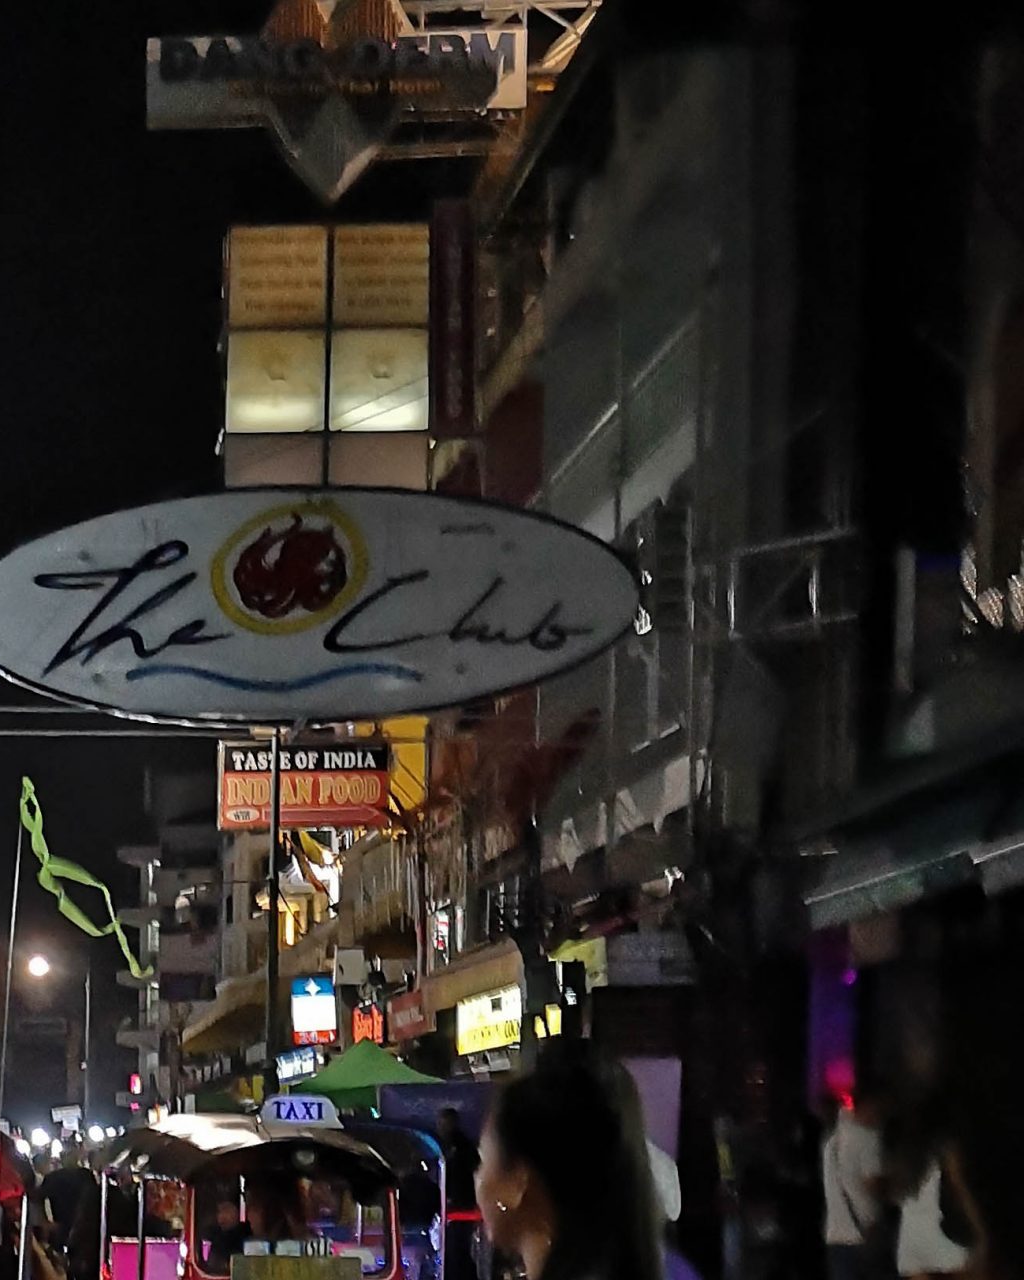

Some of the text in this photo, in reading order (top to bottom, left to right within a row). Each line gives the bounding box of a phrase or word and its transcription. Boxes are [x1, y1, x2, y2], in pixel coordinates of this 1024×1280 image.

[33, 538, 595, 679] The Club
[231, 749, 377, 771] TASE OF INDIA
[226, 774, 382, 807] INDAN FOOD
[272, 1100, 325, 1121] TAXI
